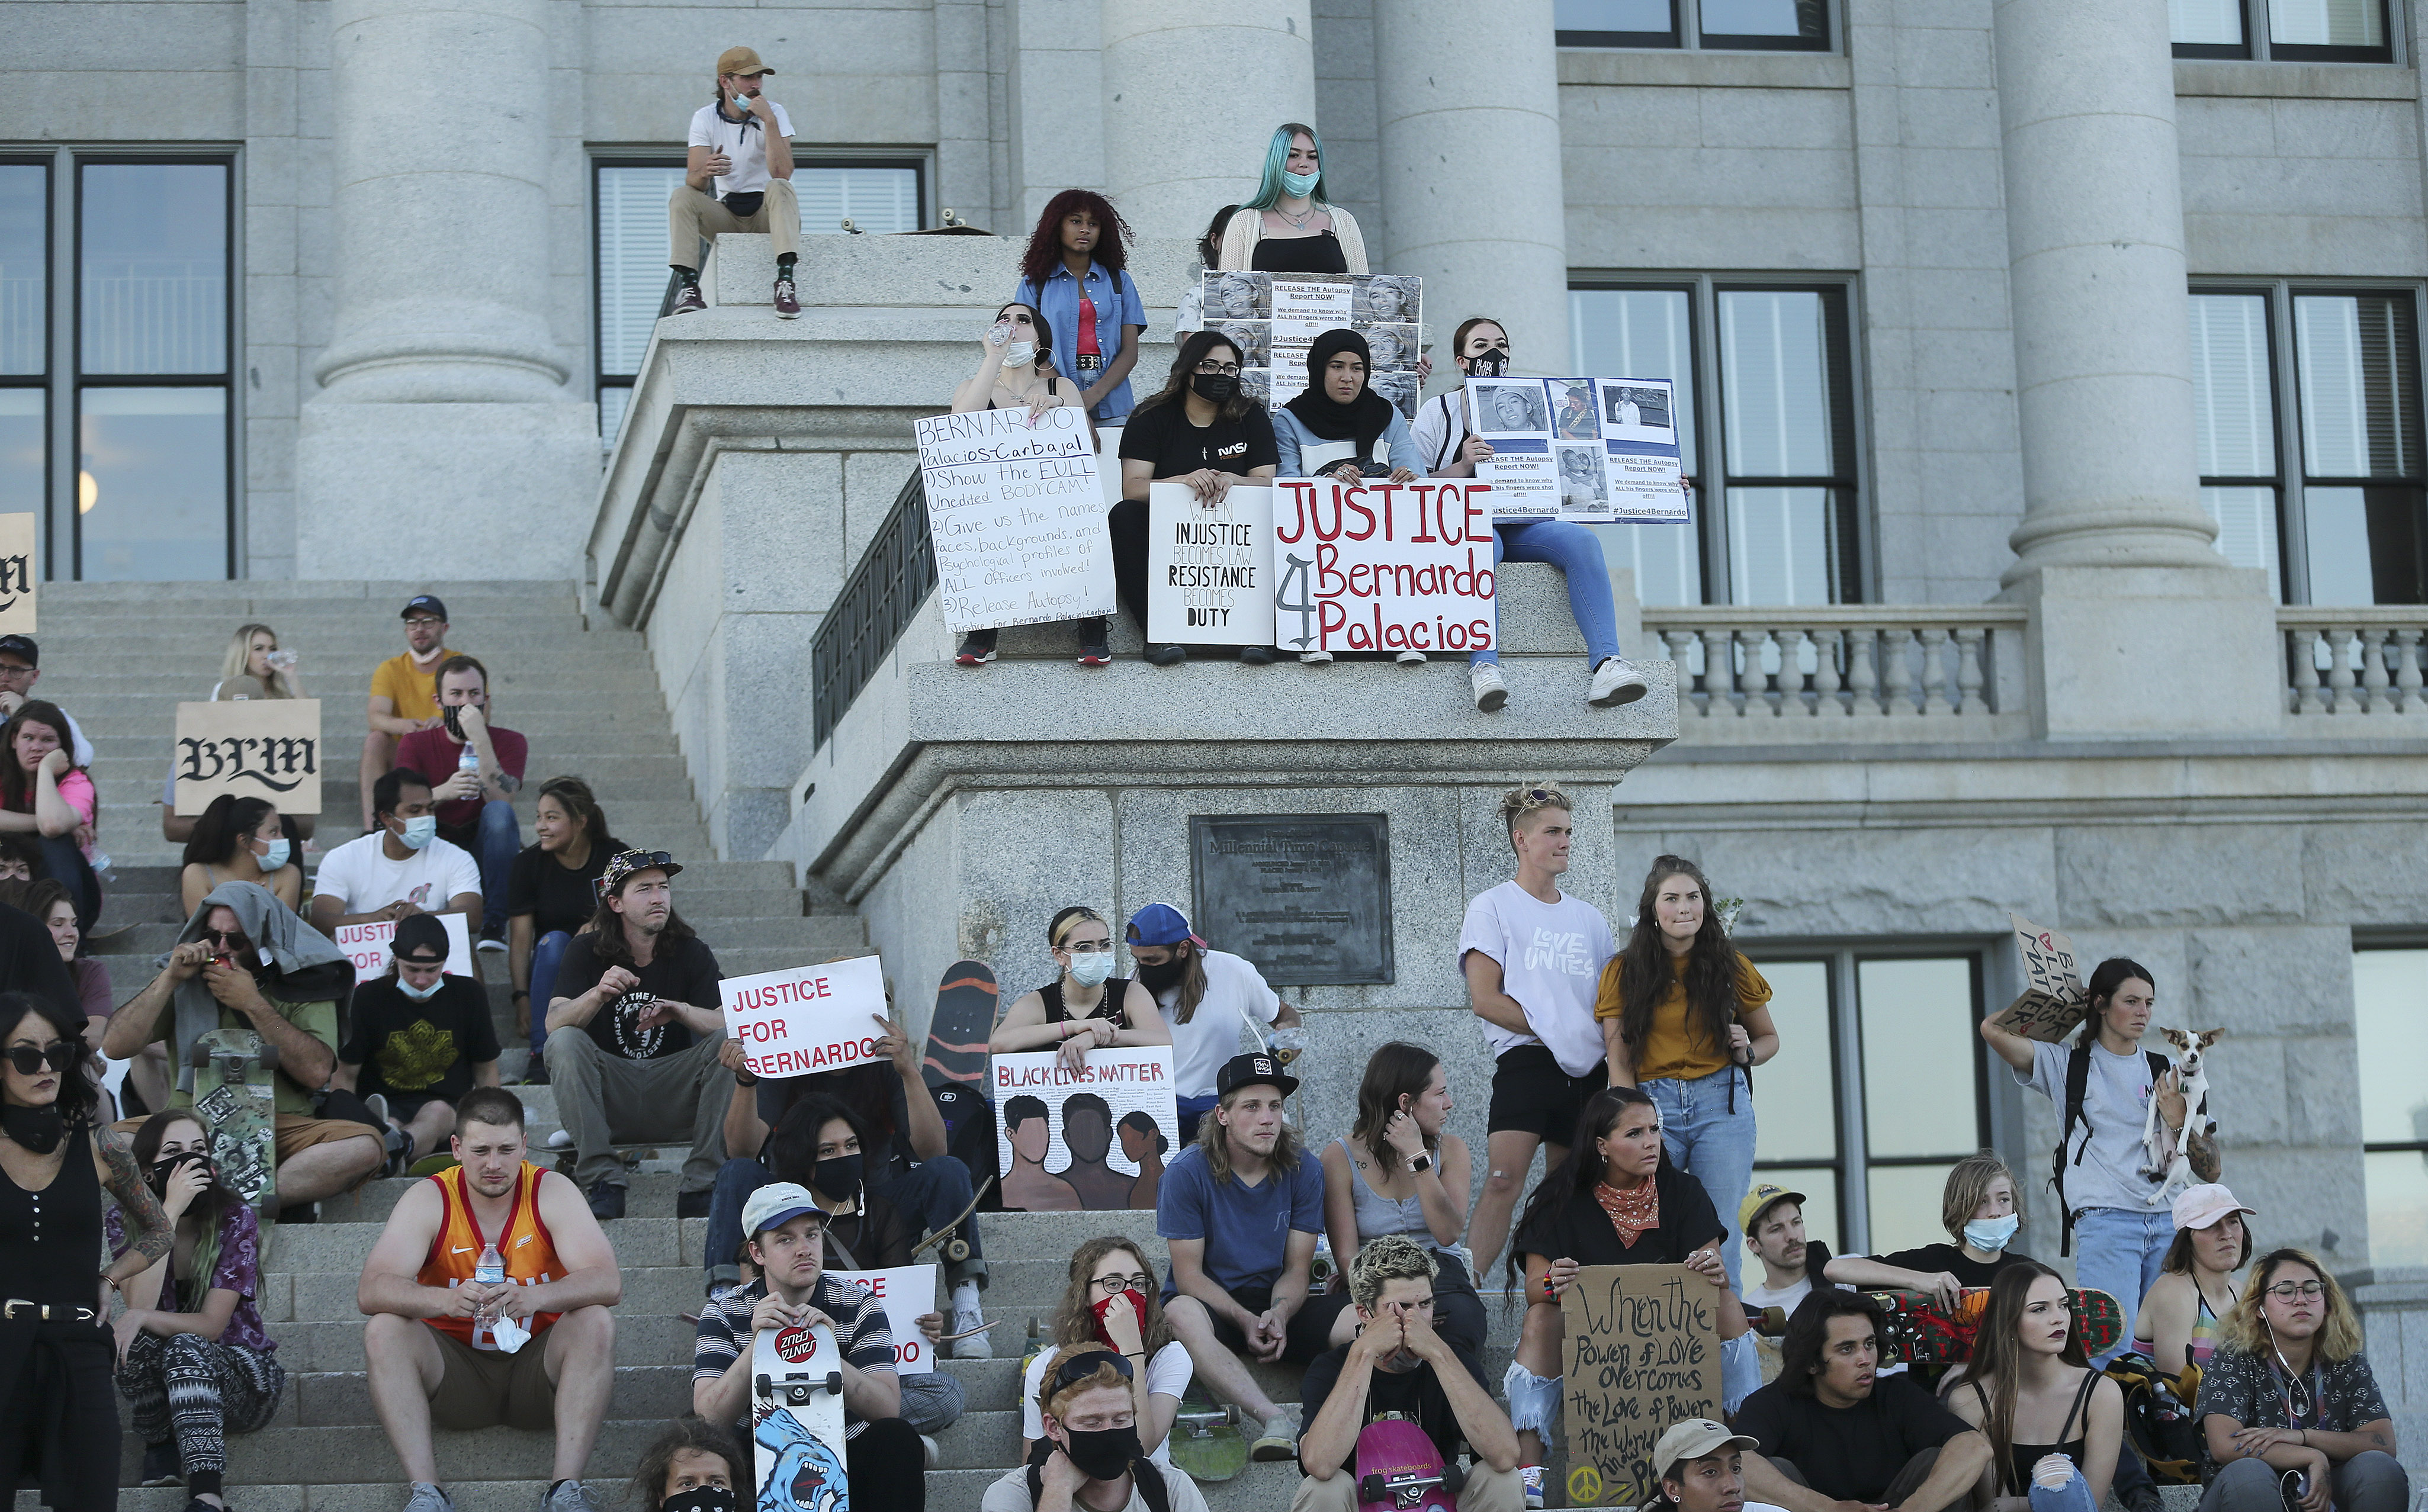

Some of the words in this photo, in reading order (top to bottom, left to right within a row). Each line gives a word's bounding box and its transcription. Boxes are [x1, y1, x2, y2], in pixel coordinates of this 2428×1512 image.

[1475, 365, 1492, 377] LIVES
[1476, 358, 1493, 368] BLACK
[918, 407, 1075, 446] BERNARDO
[921, 434, 1082, 468] Palacios-Carbajal
[997, 464, 1032, 480] the
[1039, 459, 1096, 480] FULL
[928, 492, 990, 511] Unedited
[1190, 501, 1234, 522] WHEN
[1277, 481, 1494, 546] JUSTICE
[994, 516, 1012, 527] us
[1018, 507, 1049, 526] the
[1058, 503, 1105, 519] names
[1077, 522, 1101, 538] and
[1176, 523, 1252, 546] INJUSTICE
[1022, 545, 1071, 568] profiles
[1078, 539, 1094, 554] of
[1173, 545, 1224, 565] BECOMES
[1226, 546, 1252, 565] LAW
[943, 578, 976, 594] ALL
[984, 571, 1033, 587] Officers
[1040, 559, 1090, 577] involved!
[1168, 565, 1257, 588] RESISTANCE
[1313, 543, 1495, 600] Bernardo
[1027, 586, 1090, 610] Autopsy!
[1183, 588, 1235, 607] BECOMES
[1276, 552, 1319, 650] 4
[950, 622, 985, 633] Justice
[993, 619, 1007, 629] For
[1013, 614, 1052, 626] Bernardo
[1056, 607, 1115, 622] Palacios-Carbajal
[1187, 607, 1231, 628] DUTY
[1318, 600, 1492, 652] Palacios
[1209, 839, 1278, 854] Millennial
[1282, 841, 1315, 853] Time
[1318, 839, 1371, 852] Capsule
[340, 924, 399, 944] JUSTI
[1532, 926, 1587, 956] LOVE
[346, 952, 383, 969] OR
[1524, 947, 1595, 980] UNITES
[629, 992, 649, 1001] THE
[732, 977, 832, 1012] JUSTICE
[738, 1019, 788, 1045] FOR
[746, 1037, 876, 1075] BERNARDO
[998, 1065, 1051, 1087] BLACK
[1054, 1066, 1096, 1086] LIVES
[1099, 1062, 1164, 1083] MATTER
[1576, 1276, 1666, 1337] When
[1661, 1275, 1713, 1338] the
[781, 1330, 809, 1349] CRUZ
[781, 1339, 818, 1360] SANTA
[1639, 1342, 1656, 1367] of
[1569, 1389, 1601, 1424] the
[1649, 1395, 1665, 1425] of
[1666, 1395, 1714, 1424] Power
[1613, 1425, 1656, 1453] World
[1371, 1467, 1388, 1475] frog
[1389, 1462, 1431, 1473] skateboards
